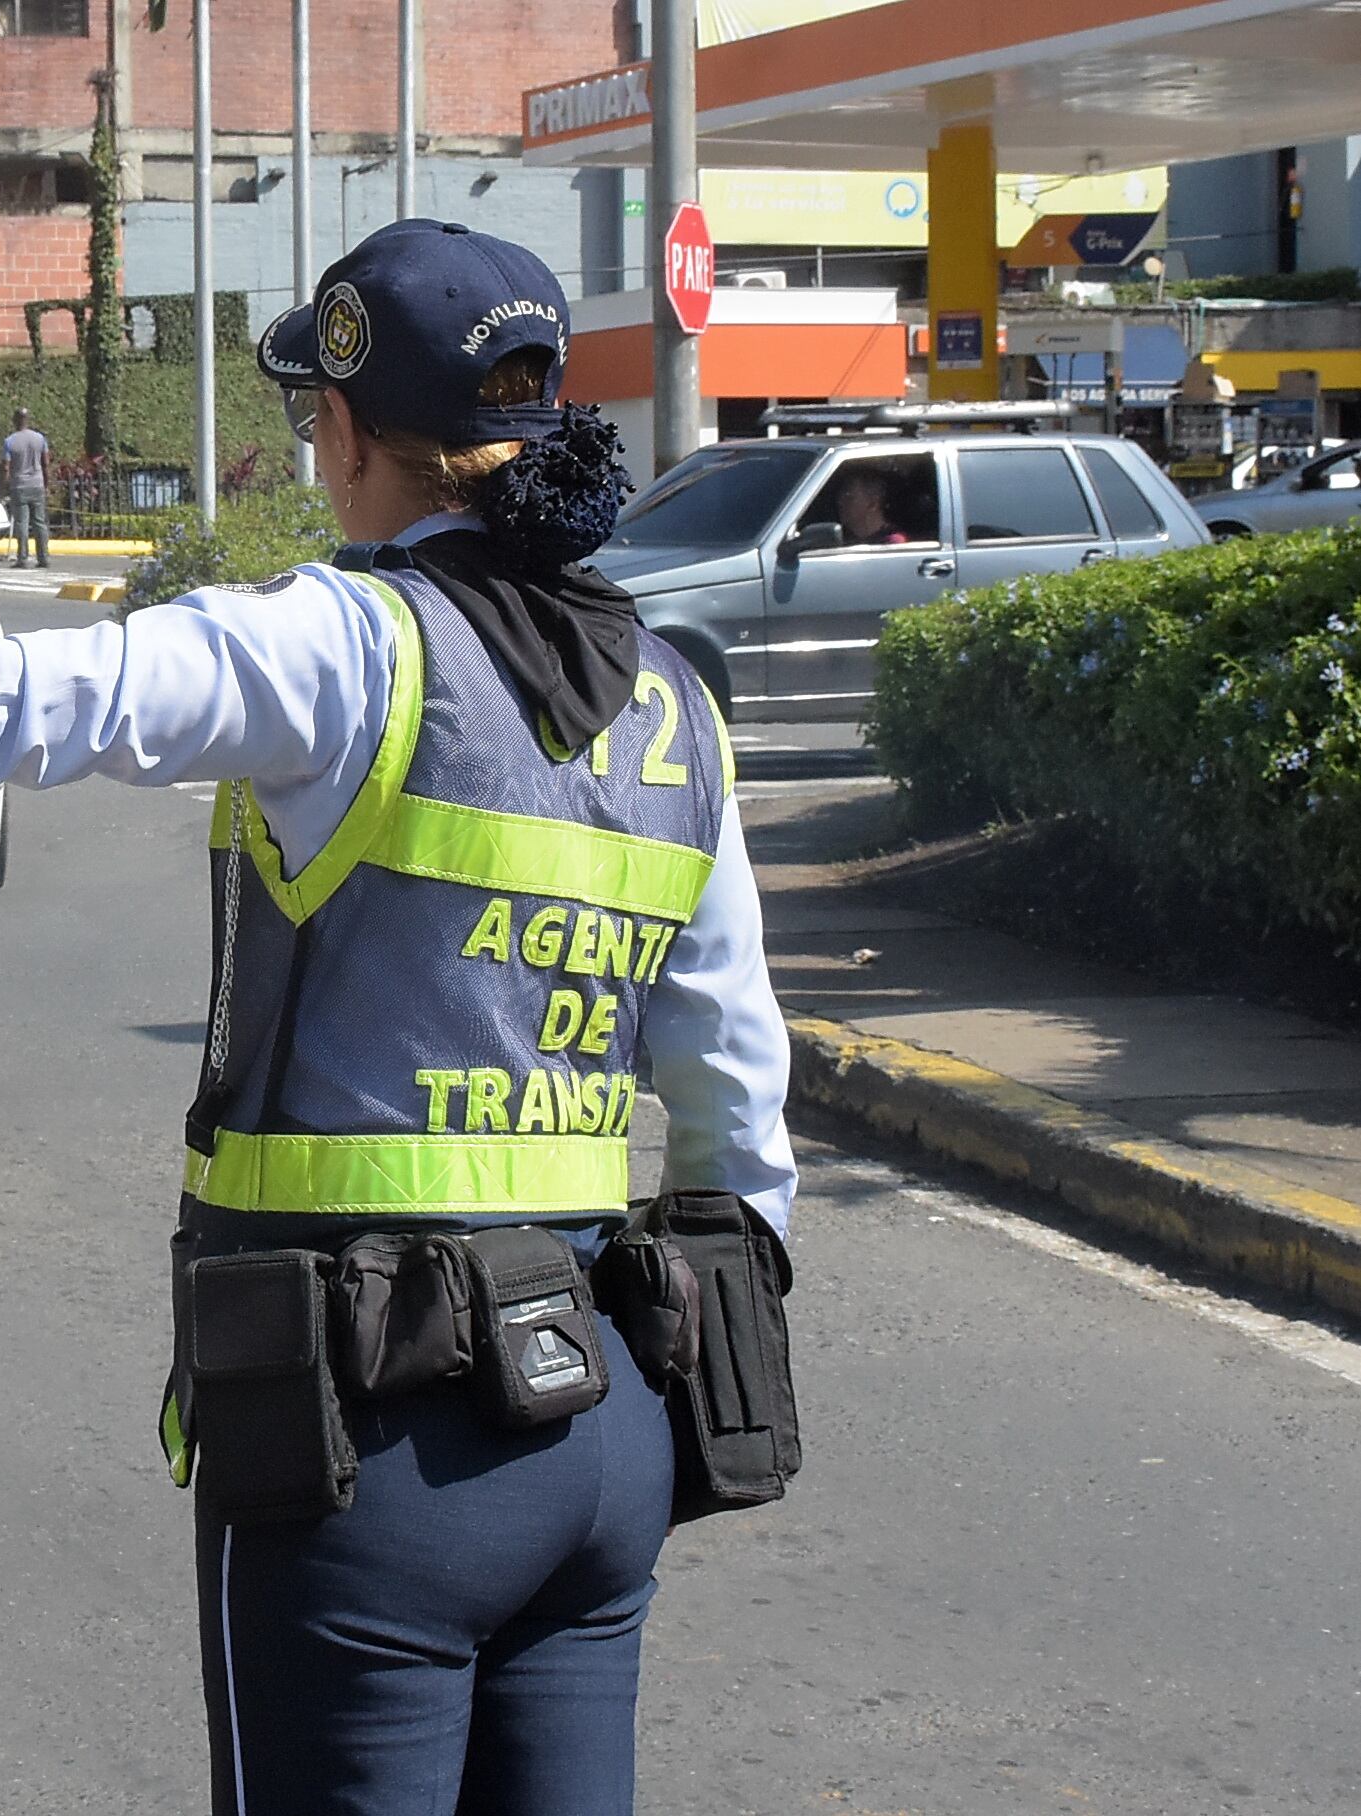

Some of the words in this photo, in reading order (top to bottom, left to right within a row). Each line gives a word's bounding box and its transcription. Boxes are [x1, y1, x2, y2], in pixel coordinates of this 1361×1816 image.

[529, 68, 652, 137] PRIMAX
[671, 243, 711, 295] PARE
[460, 300, 558, 356] MOVILIDAD
[538, 989, 619, 1055] DE
